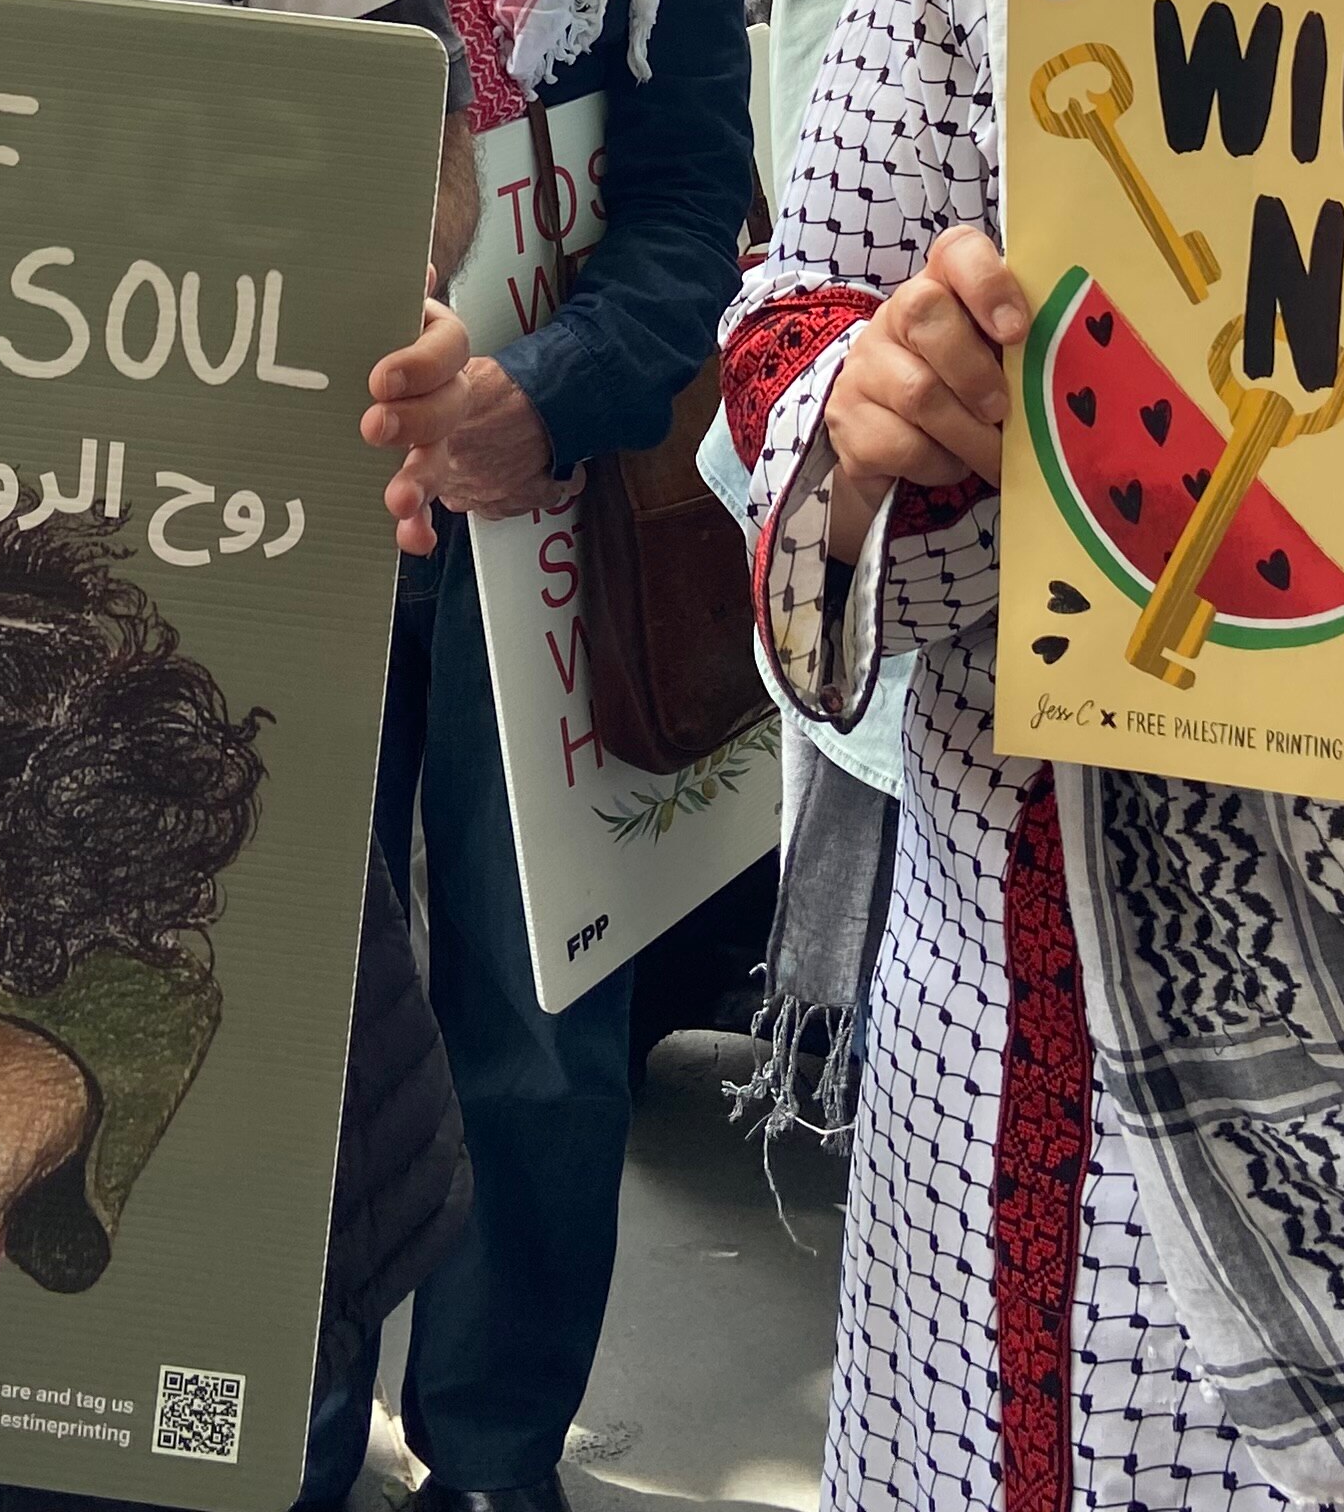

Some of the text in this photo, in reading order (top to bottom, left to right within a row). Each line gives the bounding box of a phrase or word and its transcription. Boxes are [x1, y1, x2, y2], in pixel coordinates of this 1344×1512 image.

[146, 469, 305, 566] روح
[1029, 693, 1074, 729] Jess
[1076, 699, 1095, 727] C
[1127, 710, 1167, 737] FREE
[1174, 717, 1257, 750] PALESTINE
[1266, 729, 1344, 761] PRINTING
[566, 914, 609, 963] FPP
[36, 1386, 72, 1407] and
[75, 1392, 107, 1414] tag
[111, 1398, 134, 1414] us
